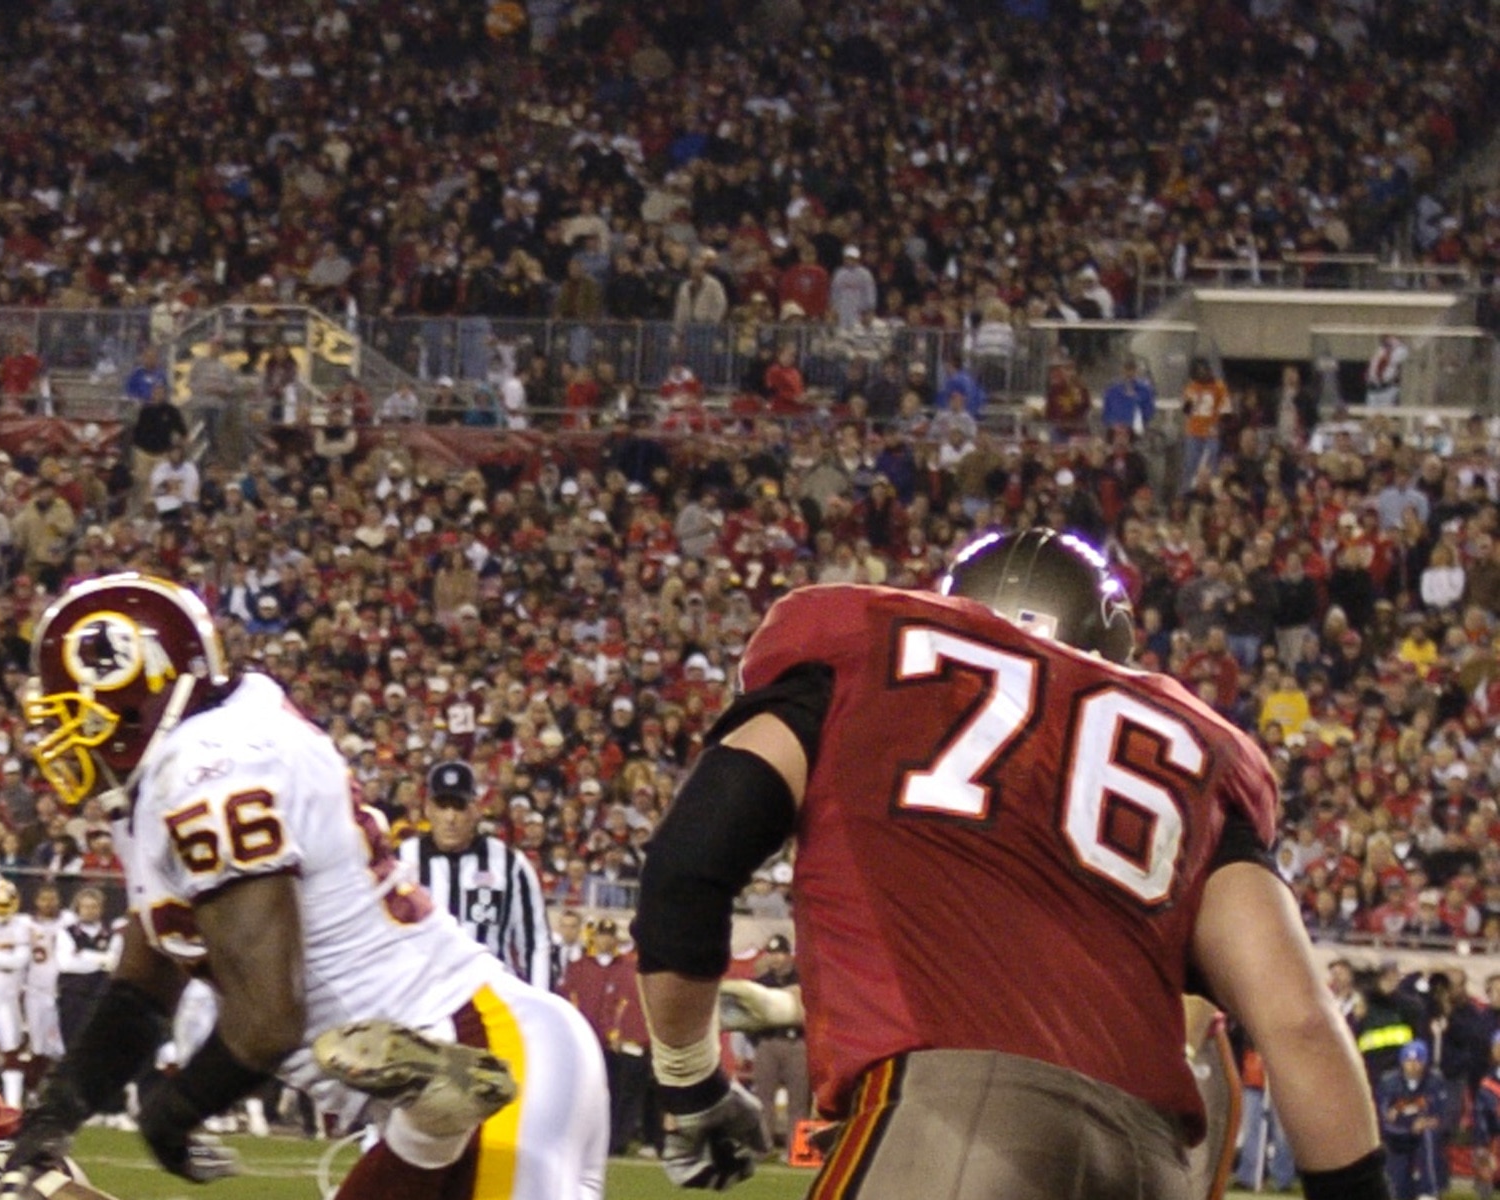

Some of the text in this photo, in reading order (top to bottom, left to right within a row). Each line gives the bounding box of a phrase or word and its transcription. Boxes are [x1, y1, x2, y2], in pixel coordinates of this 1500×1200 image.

[448, 703, 475, 734] 21
[896, 624, 1205, 905] 76
[164, 787, 285, 875] 56
